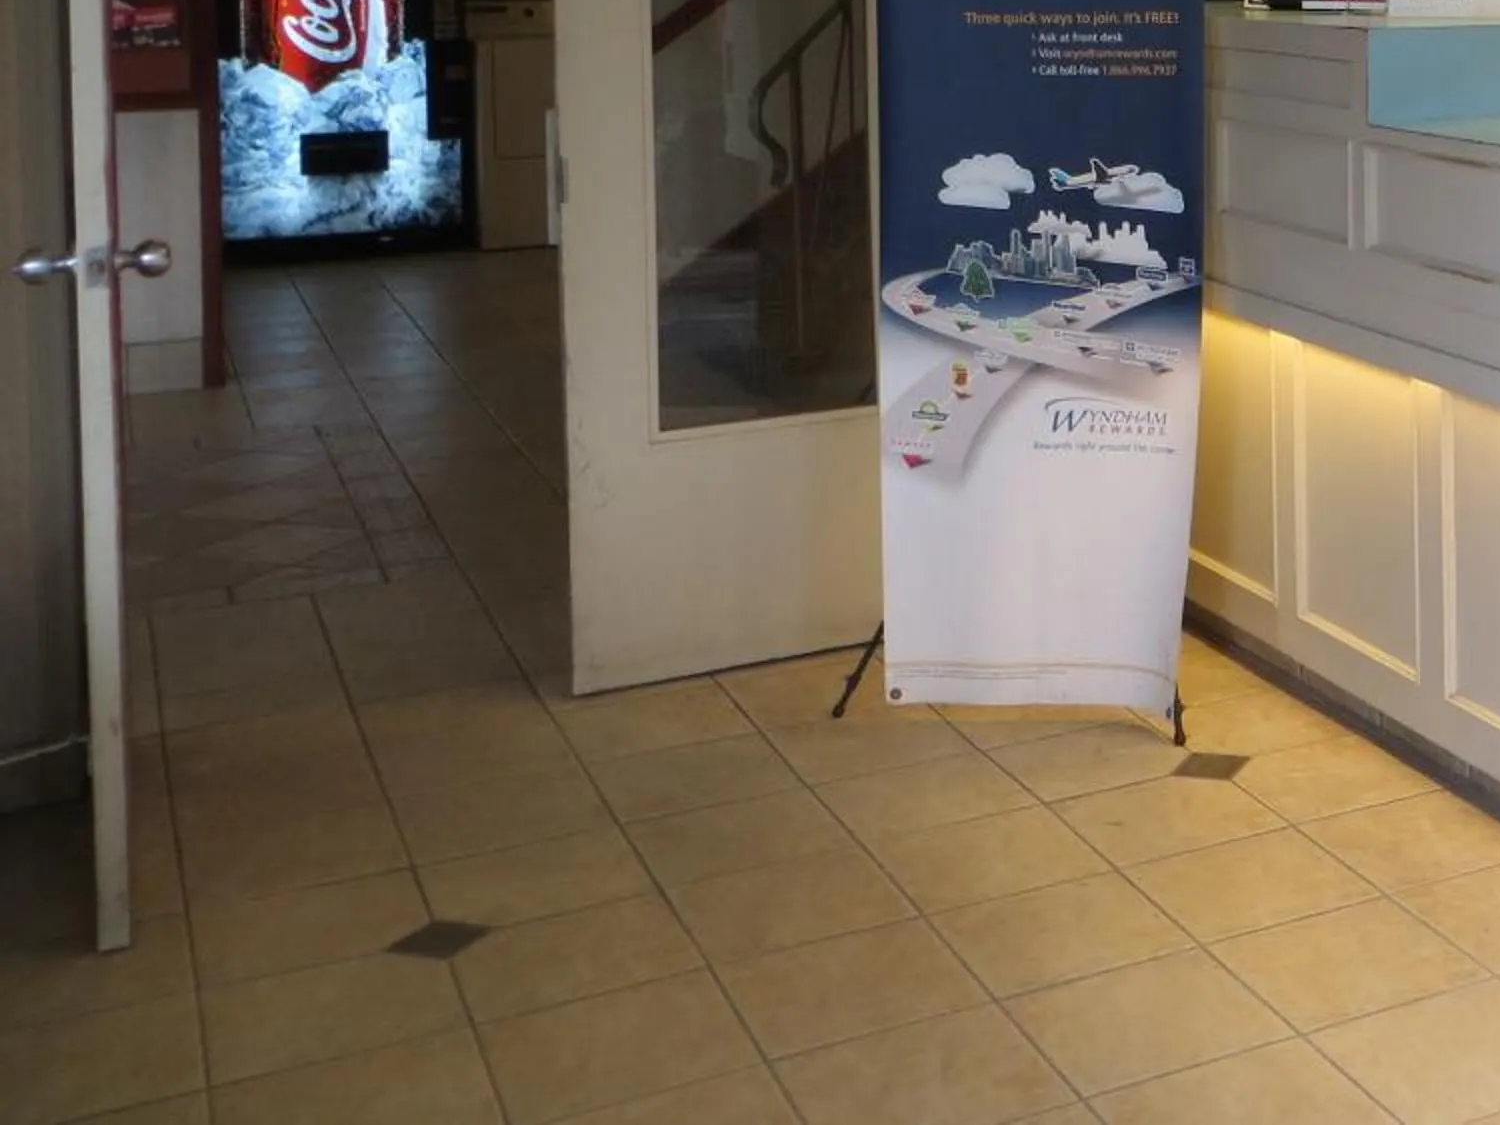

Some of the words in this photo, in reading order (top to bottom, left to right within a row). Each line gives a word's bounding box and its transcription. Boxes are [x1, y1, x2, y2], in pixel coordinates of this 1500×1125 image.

[964, 11, 1002, 25] Three
[1003, 11, 1037, 27] quick
[1040, 14, 1072, 27] ways
[1076, 13, 1090, 24] to
[1145, 12, 1180, 24] FREE!
[1038, 32, 1057, 43] Ask
[1100, 32, 1123, 43] desk
[1038, 48, 1061, 59] Visit
[1038, 64, 1058, 76] Call
[1051, 409, 1168, 433] WYNDHAM
[1089, 425, 1167, 436] REWARDS
